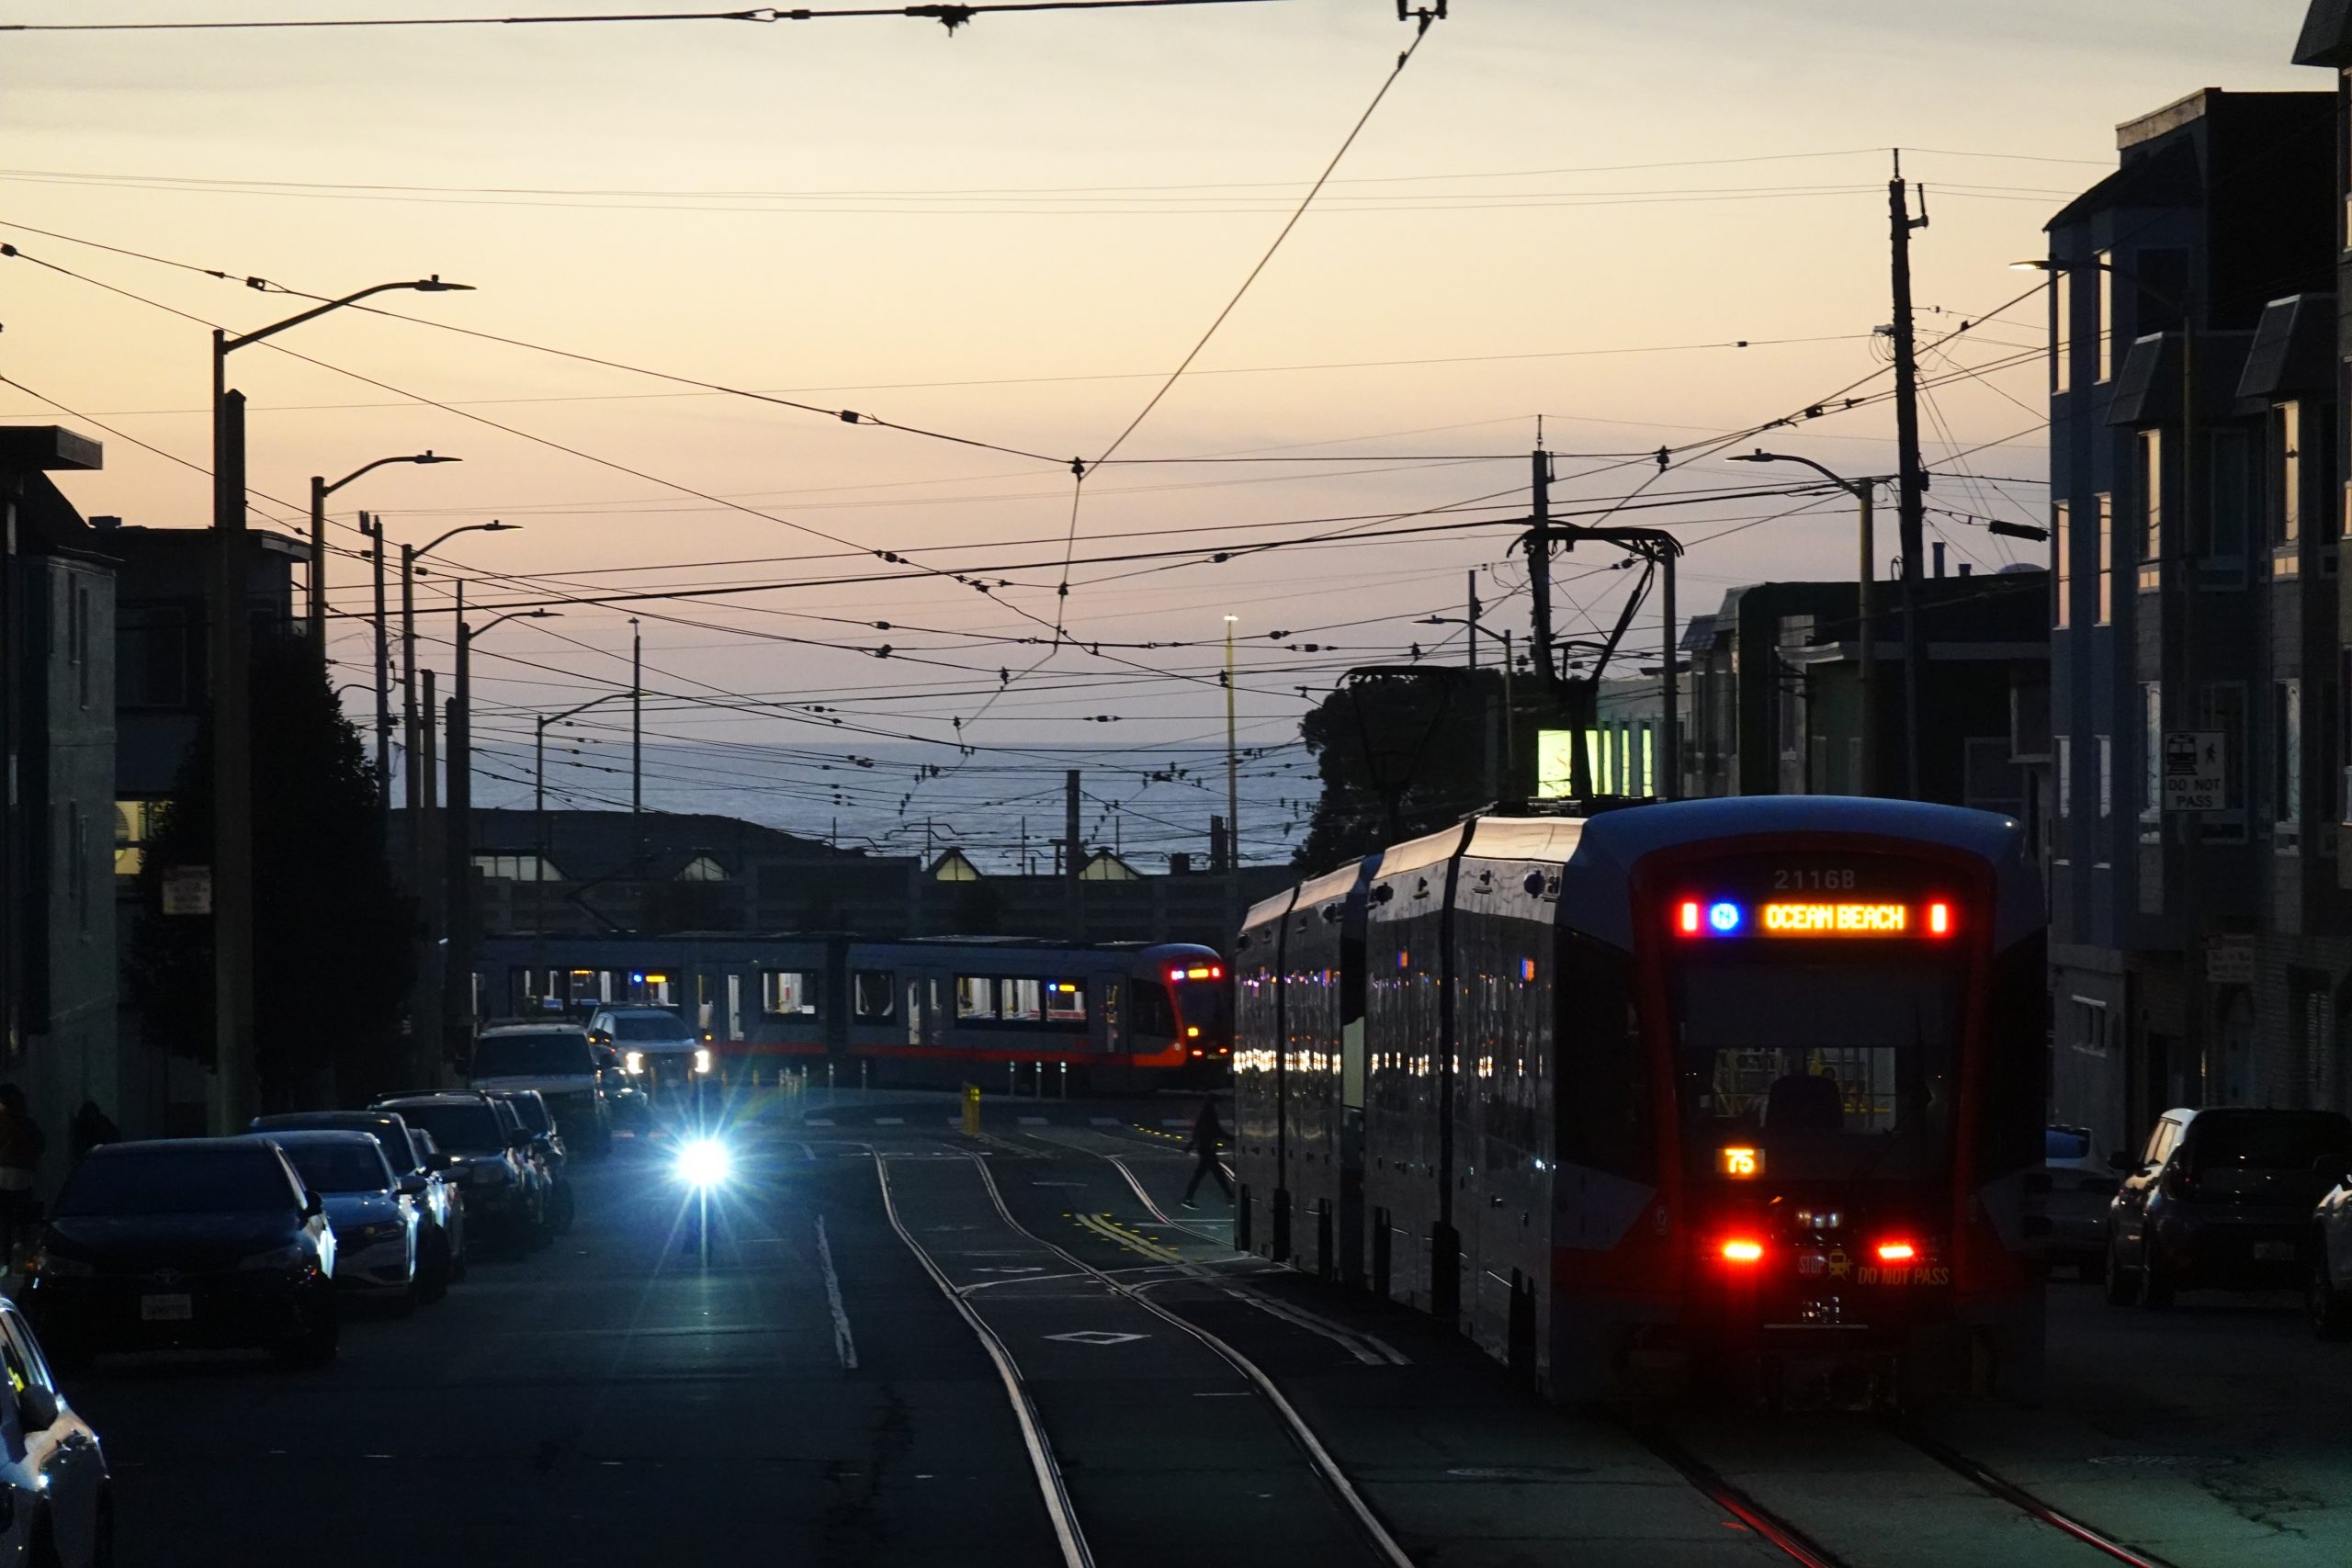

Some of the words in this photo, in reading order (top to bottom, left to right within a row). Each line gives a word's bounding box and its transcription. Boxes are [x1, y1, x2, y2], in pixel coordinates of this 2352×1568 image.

[2168, 778, 2188, 791] DO
[2194, 778, 2221, 791] NOT
[2176, 795, 2213, 807] PASS
[1773, 869, 1856, 890] 2116B
[1765, 904, 1835, 930] OCEAN
[1837, 904, 1905, 930] BEACH
[1724, 1148, 1755, 1174] 75
[1857, 1266, 1878, 1285] DO
[1882, 1267, 1910, 1285] NOT
[1914, 1267, 1950, 1285] PASS
